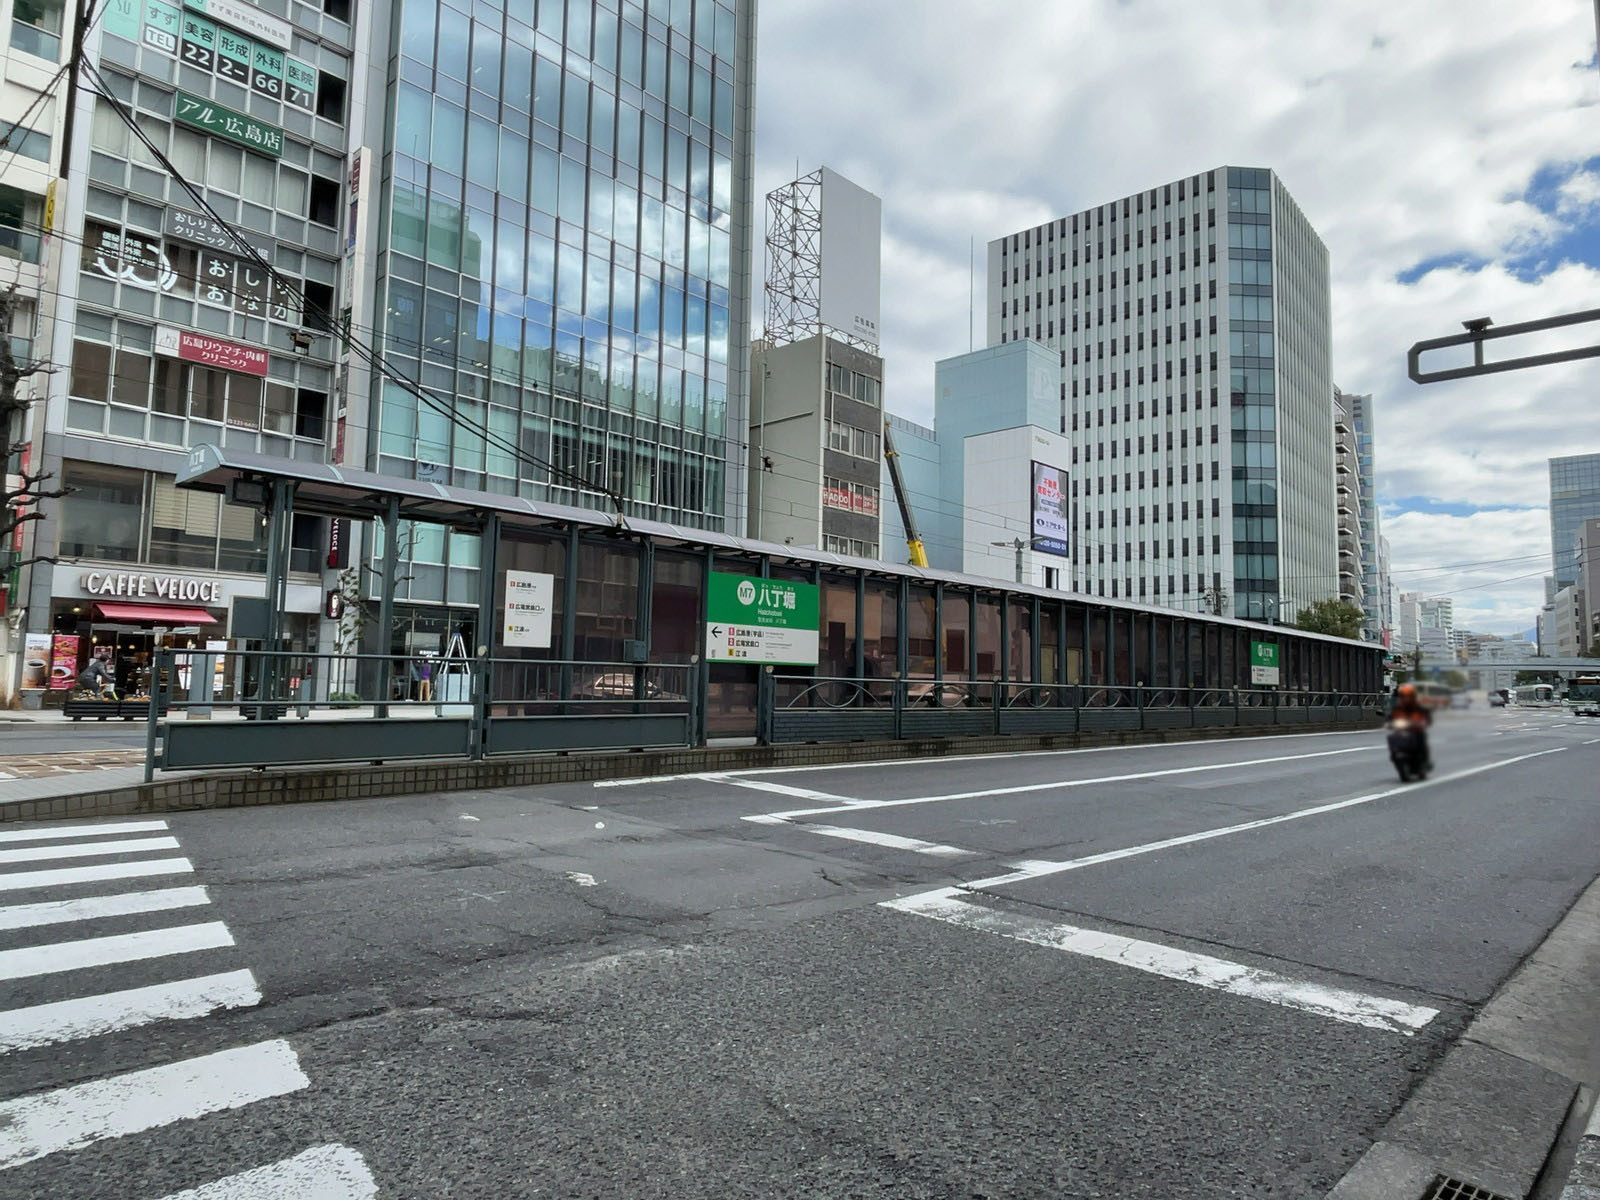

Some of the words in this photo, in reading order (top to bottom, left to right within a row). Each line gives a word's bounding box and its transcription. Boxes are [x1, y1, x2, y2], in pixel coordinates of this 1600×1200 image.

[147, 28, 174, 49] TEL
[179, 98, 281, 150] アル・広島店
[174, 212, 207, 229] おしり
[174, 225, 226, 247] クリニック
[182, 335, 265, 363] 広島リウマチ・内科
[201, 351, 247, 368] クリニック
[153, 577, 219, 602] VELOCE
[739, 586, 754, 600] M7
[758, 588, 796, 610] 八丁堀
